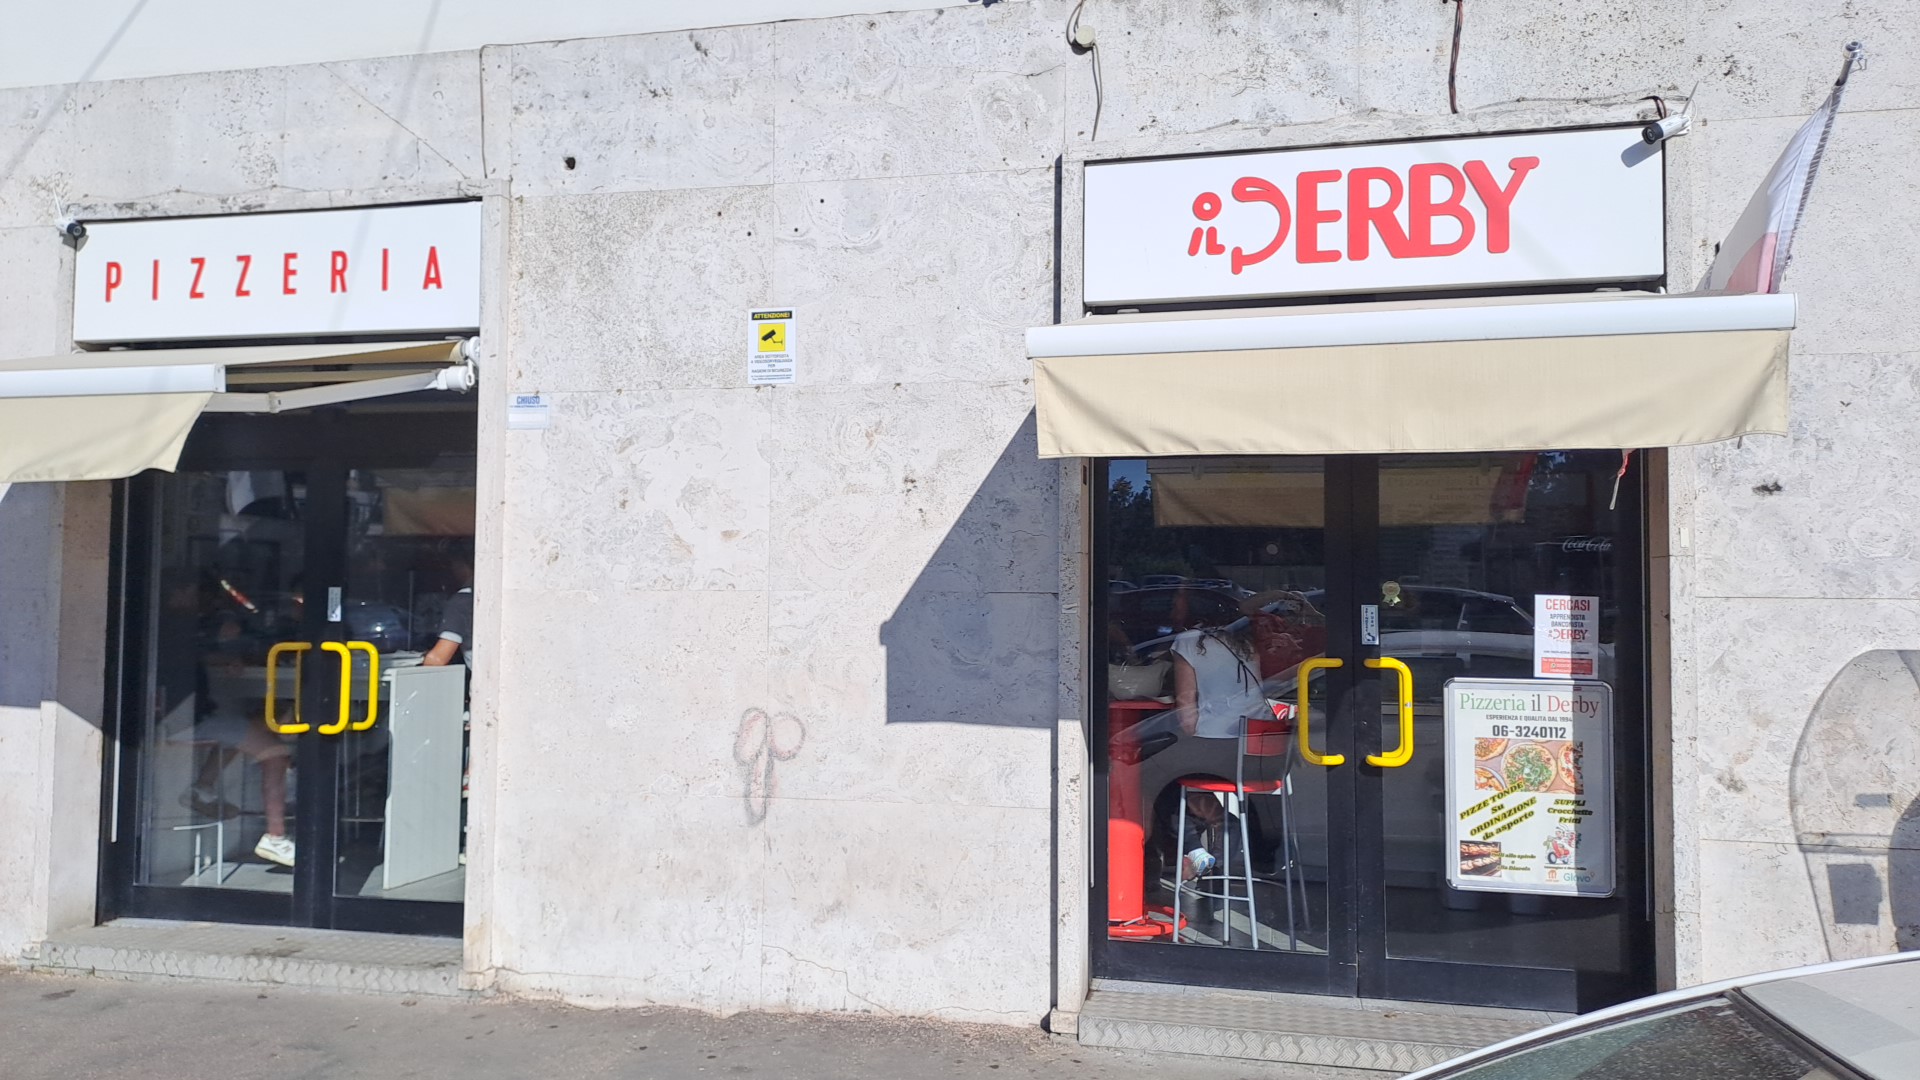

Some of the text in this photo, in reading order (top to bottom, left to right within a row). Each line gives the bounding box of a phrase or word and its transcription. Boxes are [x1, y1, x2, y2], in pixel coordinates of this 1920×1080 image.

[1231, 155, 1540, 275] DERBY
[104, 245, 443, 303] PIZZERIA
[753, 311, 791, 319] ATTENZIONE!
[516, 395, 541, 405] CHIUSO
[1545, 598, 1591, 611] CERCASI
[1549, 613, 1586, 621] APPRENDISTA
[1459, 692, 1600, 718] Pizzeria il Derby
[1492, 724, 1567, 739] 06-3240112
[1459, 780, 1525, 820] PIZZE TONDE
[1491, 803, 1506, 814] Su
[1469, 796, 1538, 837] ORDINAZIONE
[1482, 809, 1535, 841] da asporto
[1563, 872, 1591, 883] Glovo
